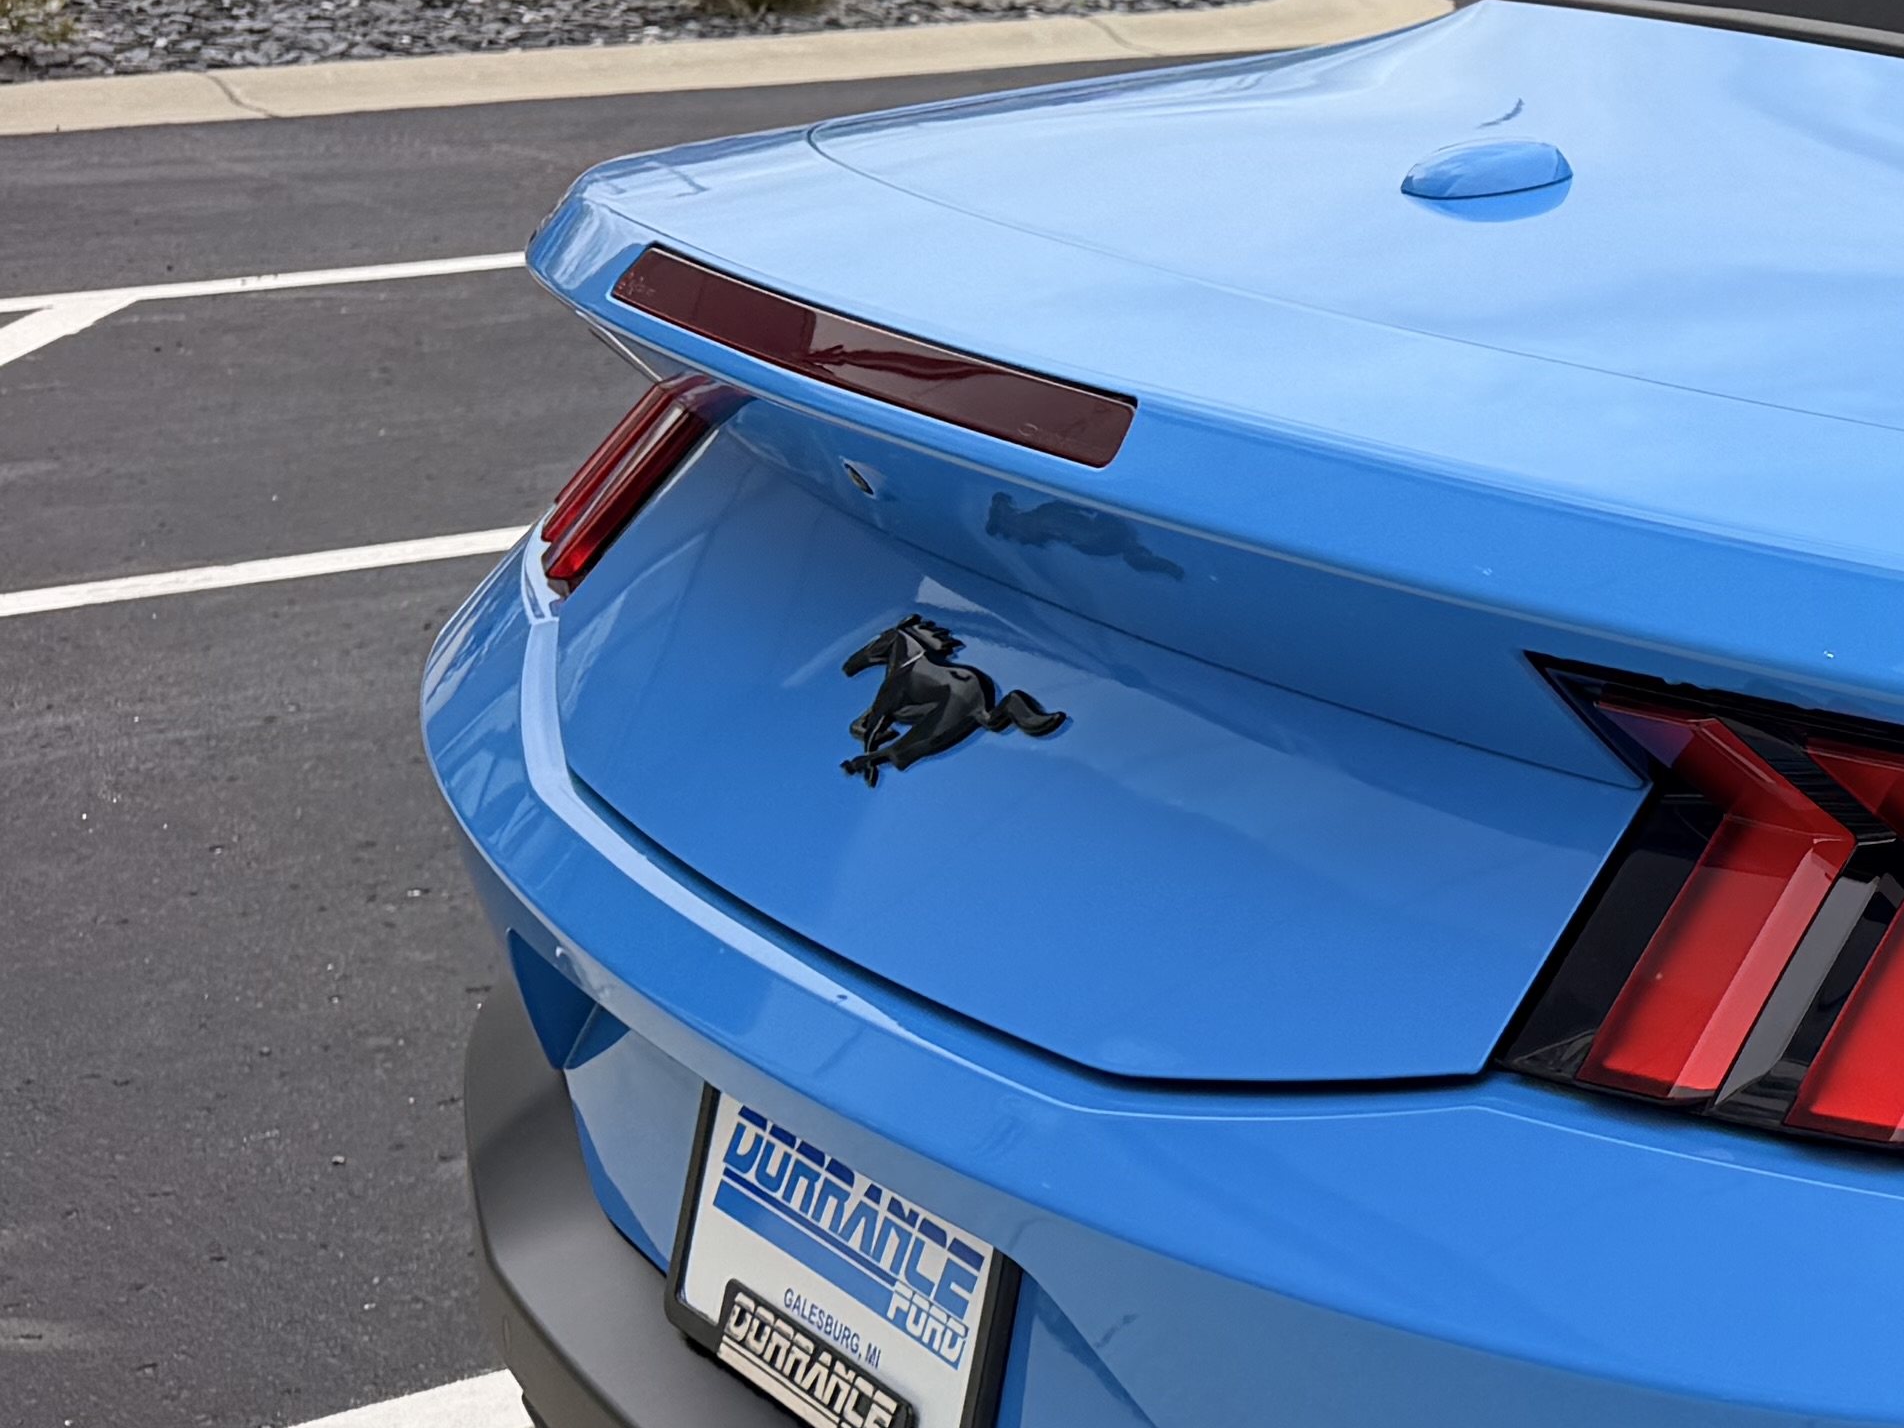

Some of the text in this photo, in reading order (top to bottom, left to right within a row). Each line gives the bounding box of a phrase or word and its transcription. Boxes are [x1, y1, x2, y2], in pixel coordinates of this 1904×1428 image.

[723, 1105, 985, 1320] DURRANCE
[783, 1287, 881, 1369] GALESBURG, MI
[886, 1286, 969, 1364] FORD
